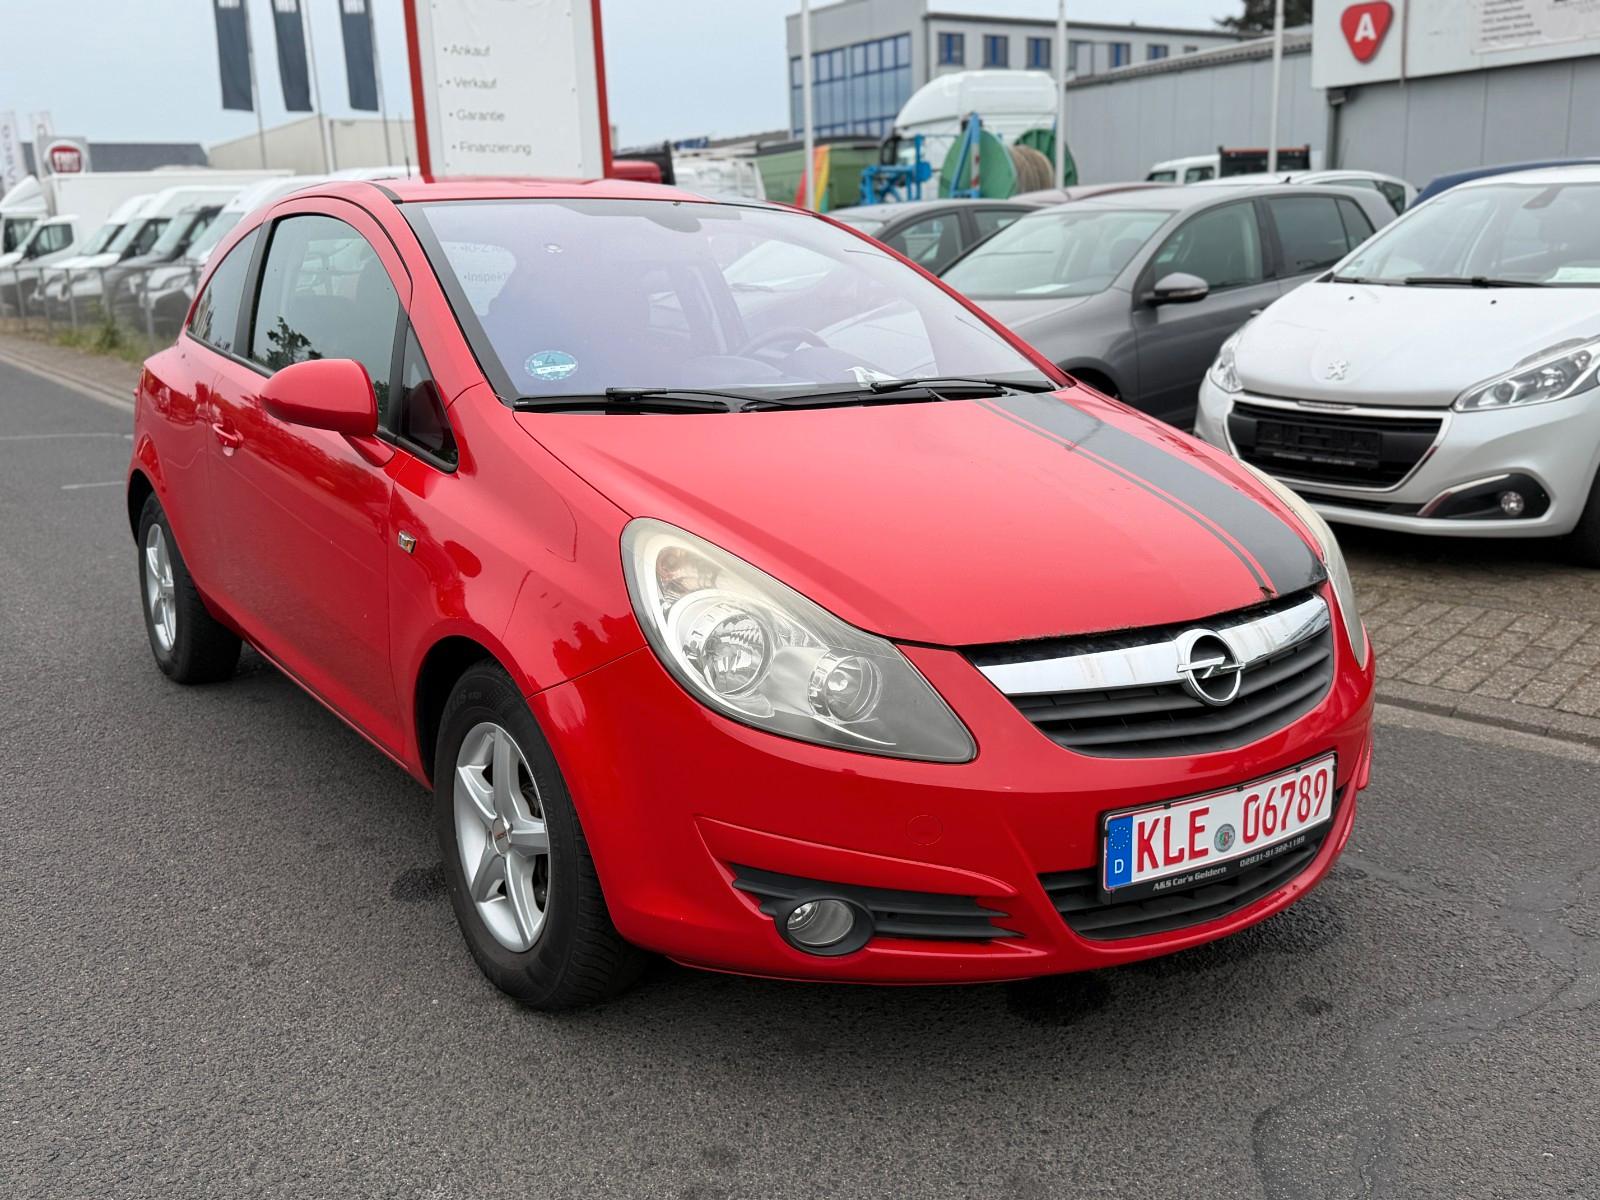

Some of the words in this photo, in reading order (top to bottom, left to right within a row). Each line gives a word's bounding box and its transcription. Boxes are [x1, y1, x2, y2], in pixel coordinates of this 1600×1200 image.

[1353, 12, 1378, 43] A
[450, 44, 491, 57] Ankauf
[453, 76, 498, 89] Verkauf
[456, 108, 505, 122] Garantie
[459, 141, 532, 156] Finanzierung
[1114, 858, 1125, 874] D
[1136, 806, 1210, 874] KLE
[1242, 767, 1328, 845] 06789
[1172, 873, 1194, 887] Car's
[1194, 866, 1227, 880] Geldern
